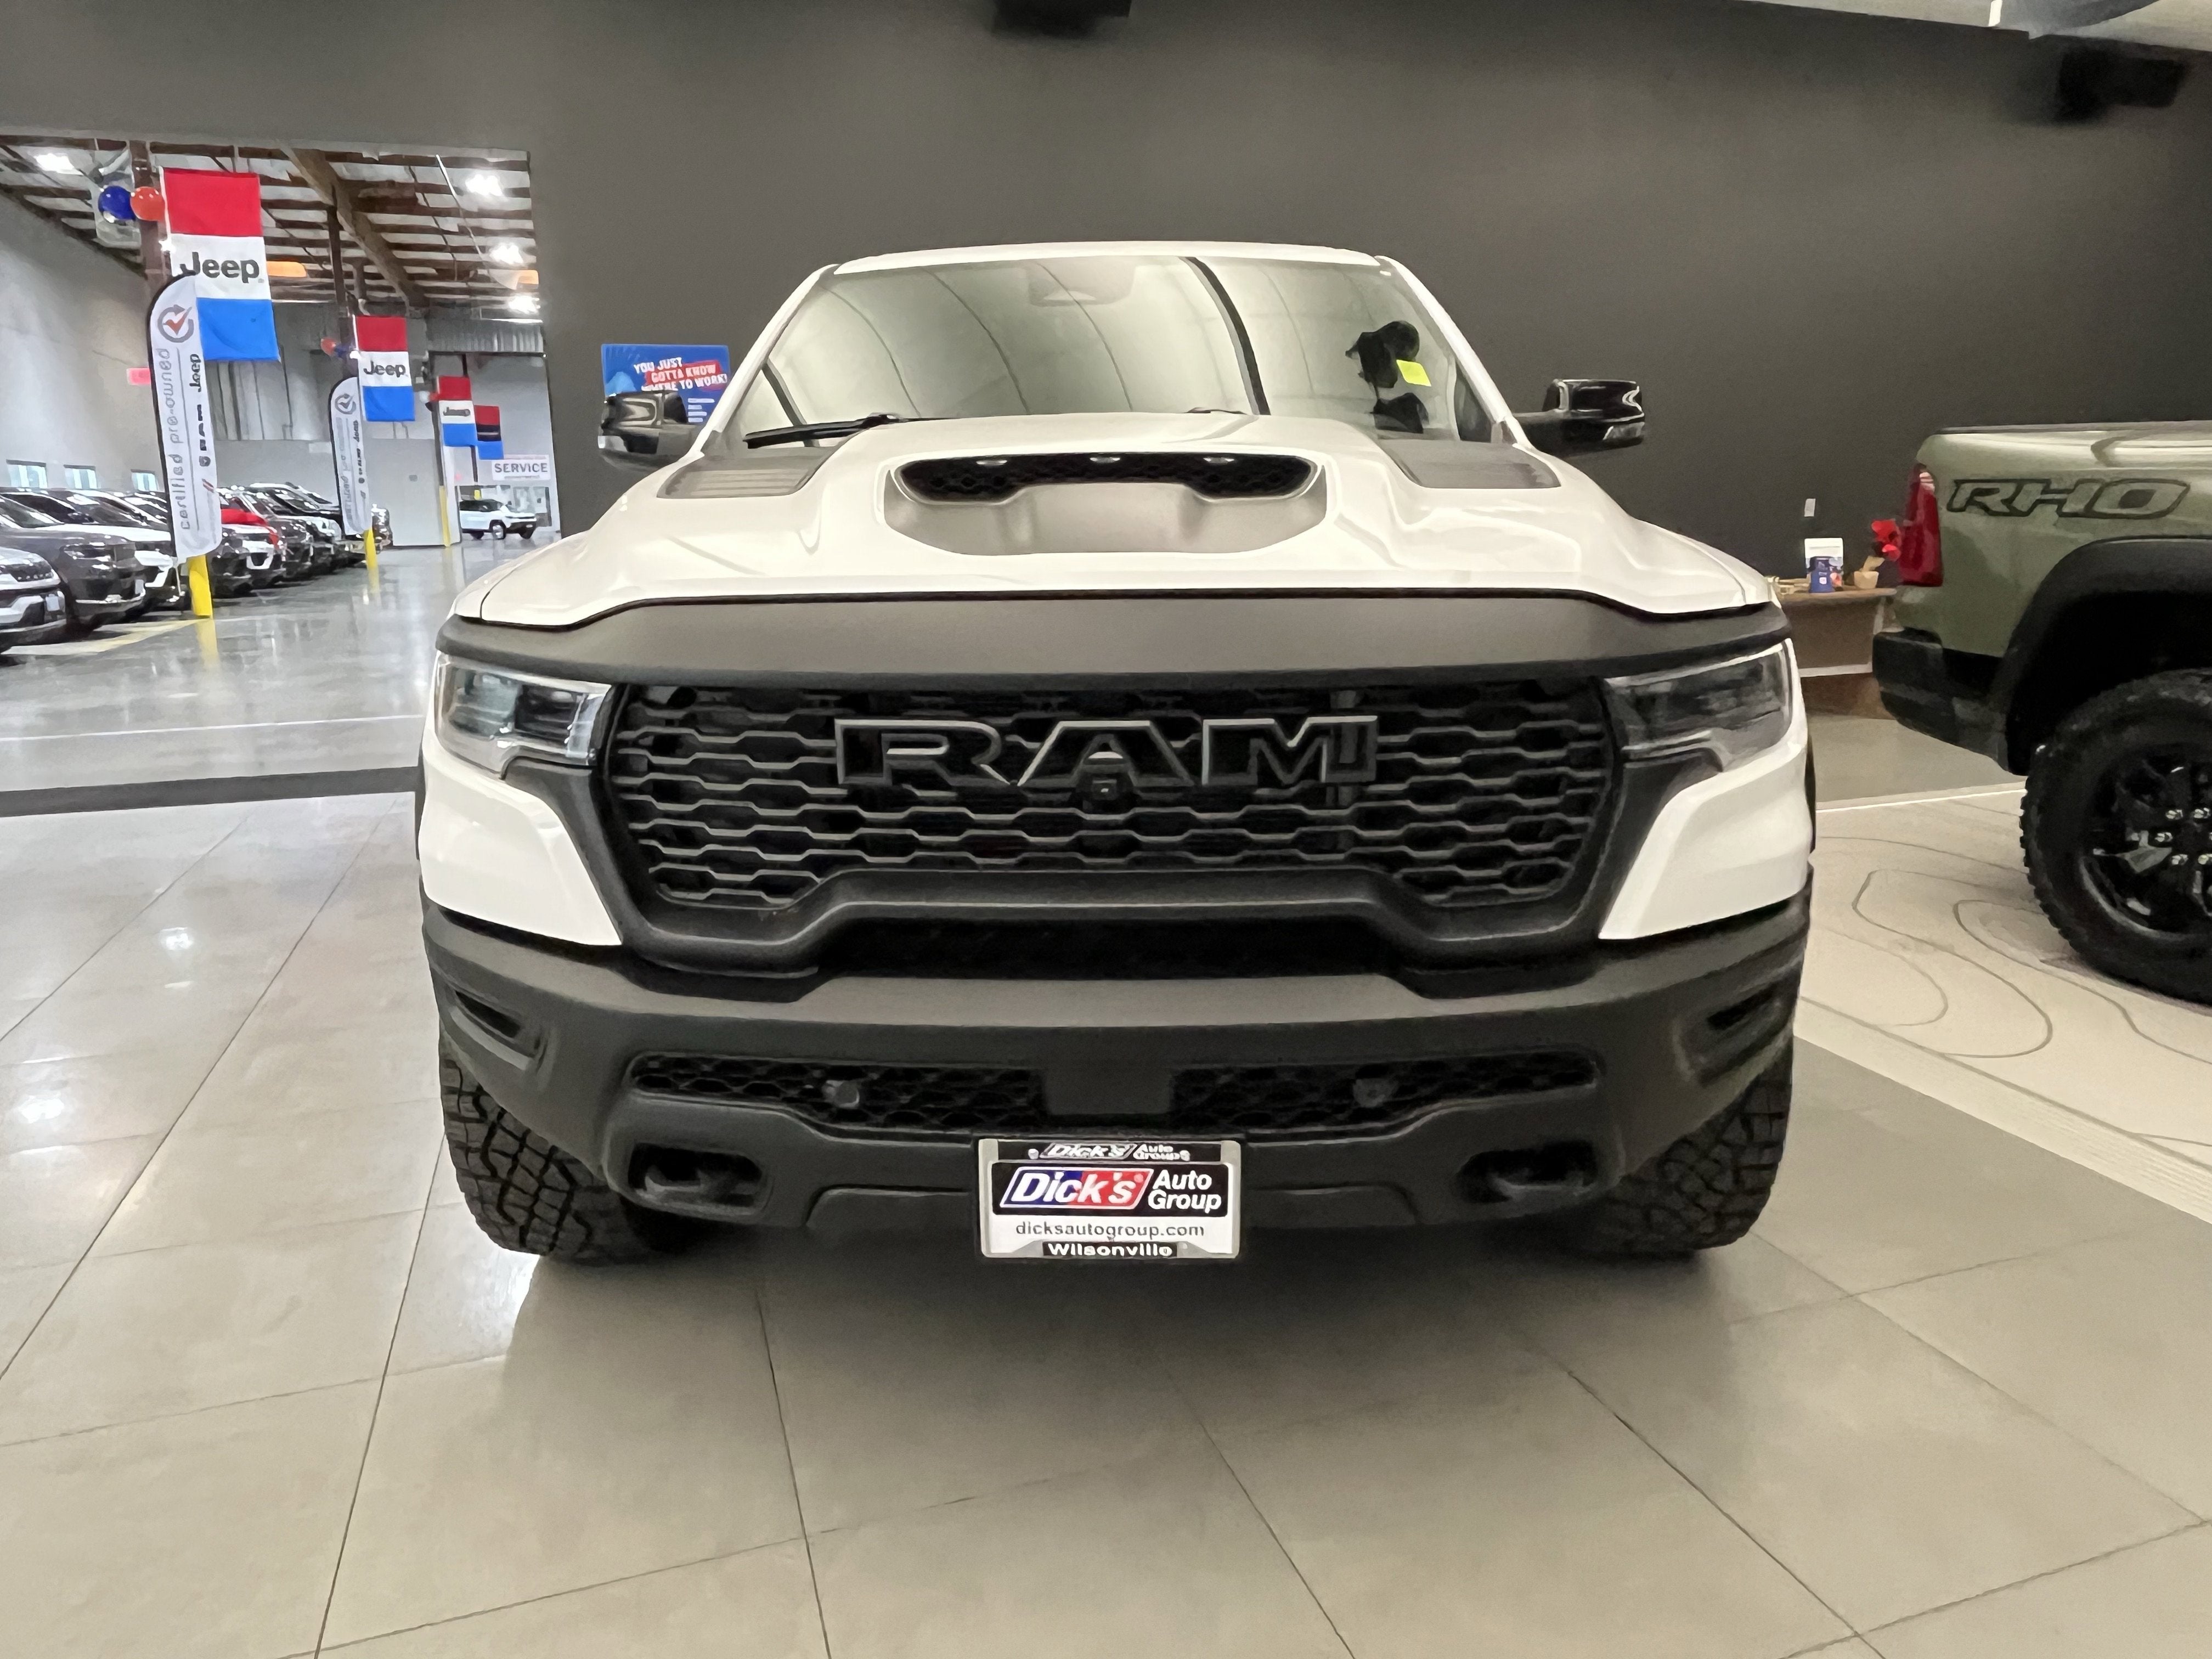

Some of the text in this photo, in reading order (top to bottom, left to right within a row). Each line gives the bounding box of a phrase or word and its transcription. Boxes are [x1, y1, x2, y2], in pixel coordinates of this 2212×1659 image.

[180, 251, 259, 284] Jeep
[189, 353, 201, 392] Jeep
[363, 360, 406, 378] Jeep
[634, 357, 682, 374] YOU JUST
[651, 364, 716, 383] GOTTA KNOW
[679, 379, 693, 389] TO
[156, 348, 184, 444] pre-owned
[443, 407, 471, 417] Jp
[494, 462, 548, 472] SERVICE
[1946, 478, 2191, 520] RHO
[834, 715, 1378, 788] RAM
[1137, 1144, 1173, 1153] Auto
[1011, 1172, 1136, 1204] Dick's
[1153, 1169, 1212, 1191] Auto
[1148, 1189, 1222, 1214] Group
[1015, 1221, 1205, 1240] dicksautogroup.com
[1047, 1243, 1172, 1256] Wilsonville
